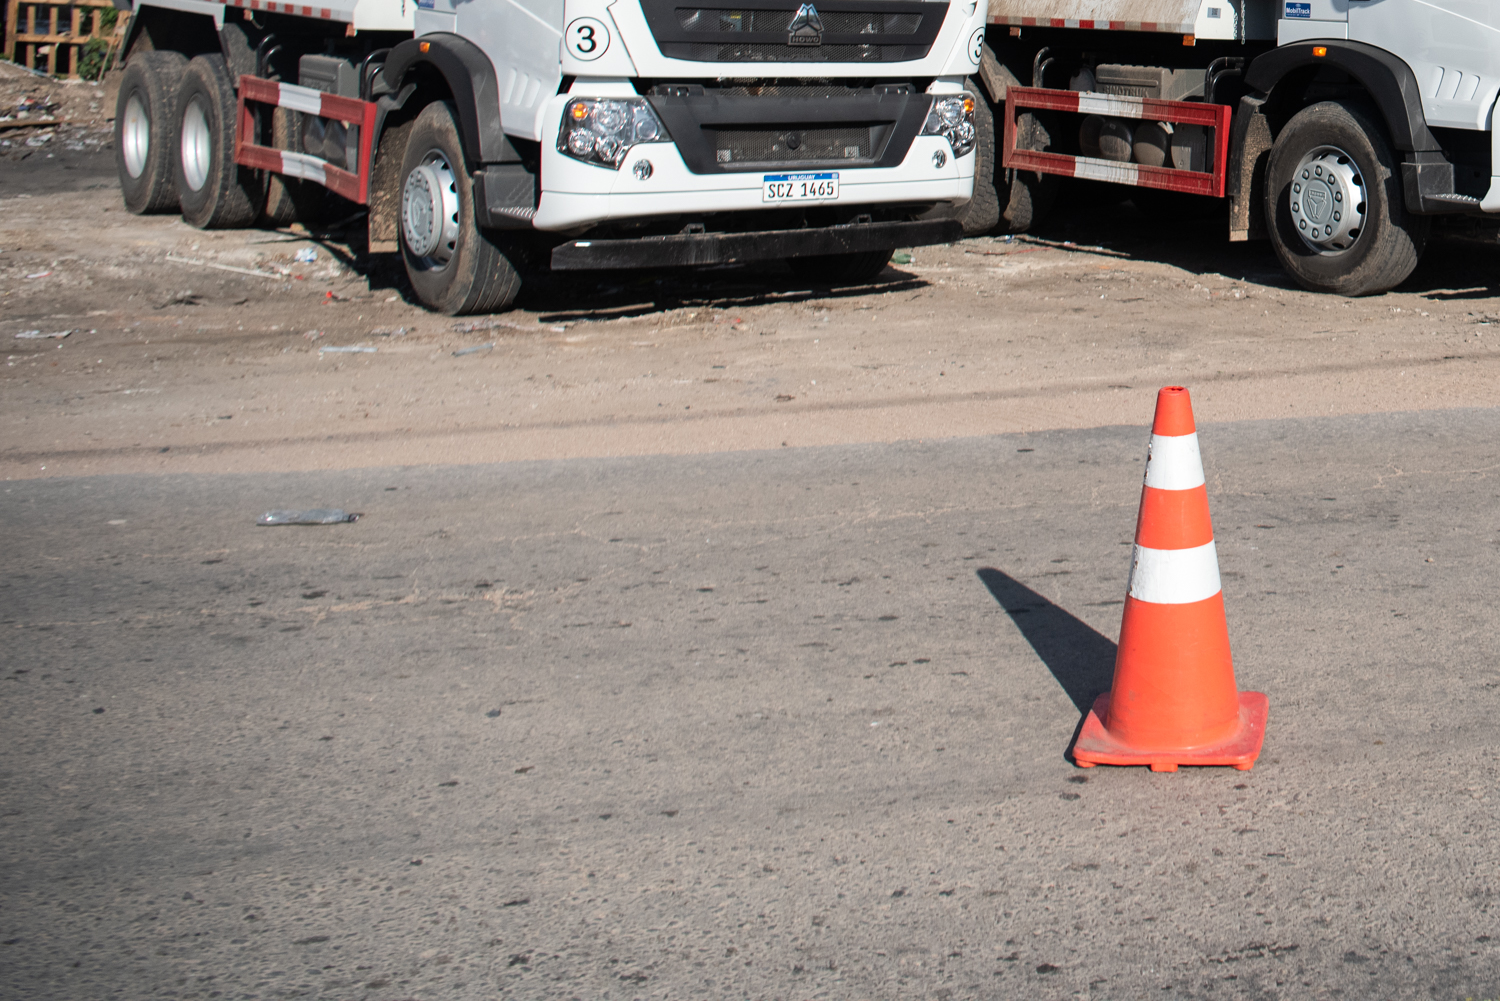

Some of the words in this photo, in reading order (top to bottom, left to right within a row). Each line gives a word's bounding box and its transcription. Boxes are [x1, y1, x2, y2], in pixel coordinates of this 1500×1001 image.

[576, 25, 597, 53] 3
[792, 36, 820, 44] HOWO
[975, 33, 984, 58] 3
[768, 182, 794, 198] SCZ
[801, 181, 834, 197] 1465
